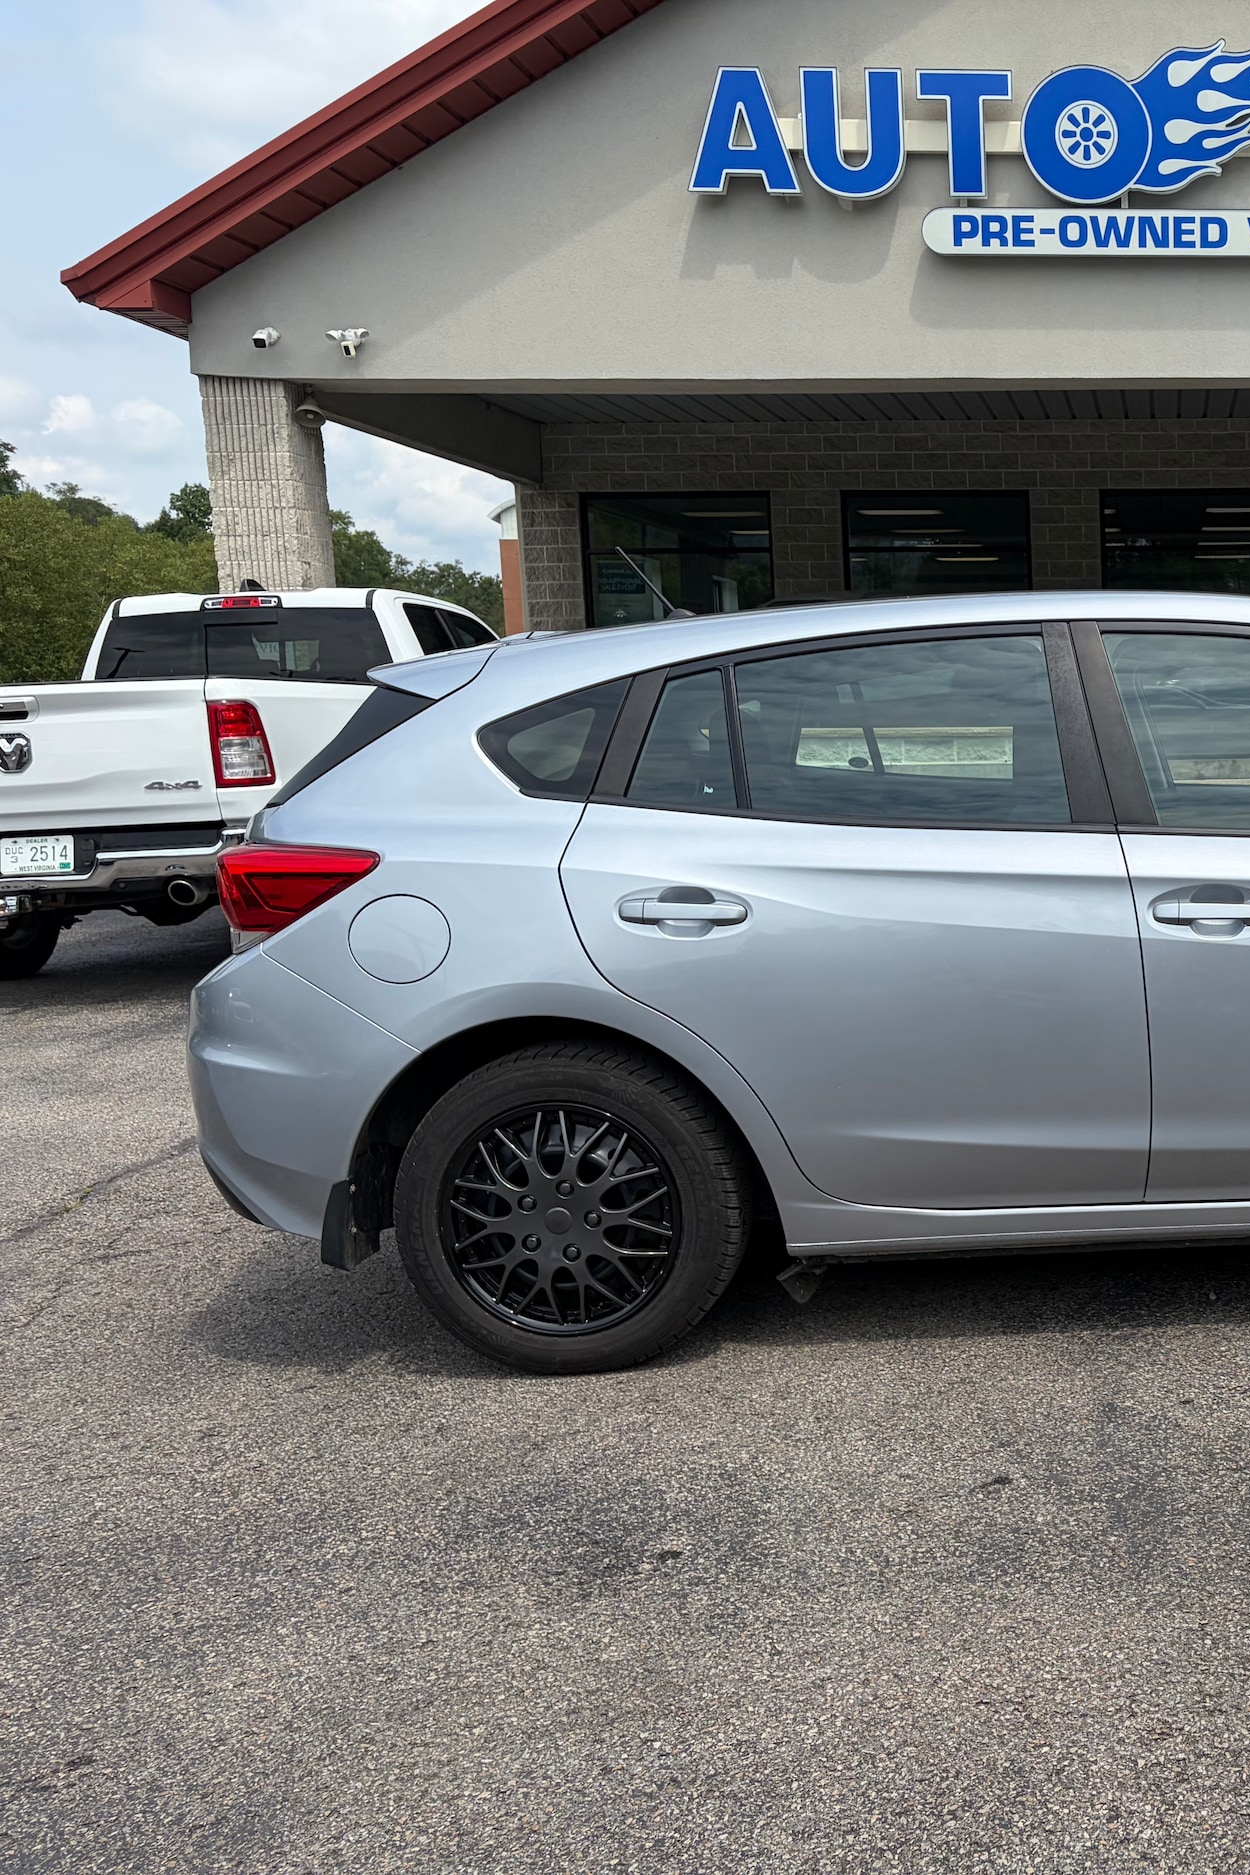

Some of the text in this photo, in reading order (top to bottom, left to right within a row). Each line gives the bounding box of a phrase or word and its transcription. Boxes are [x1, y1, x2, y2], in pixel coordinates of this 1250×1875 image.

[688, 64, 1152, 205] AUTO
[952, 214, 1229, 249] PRE-OWNED
[5, 845, 68, 861] DUC 2514
